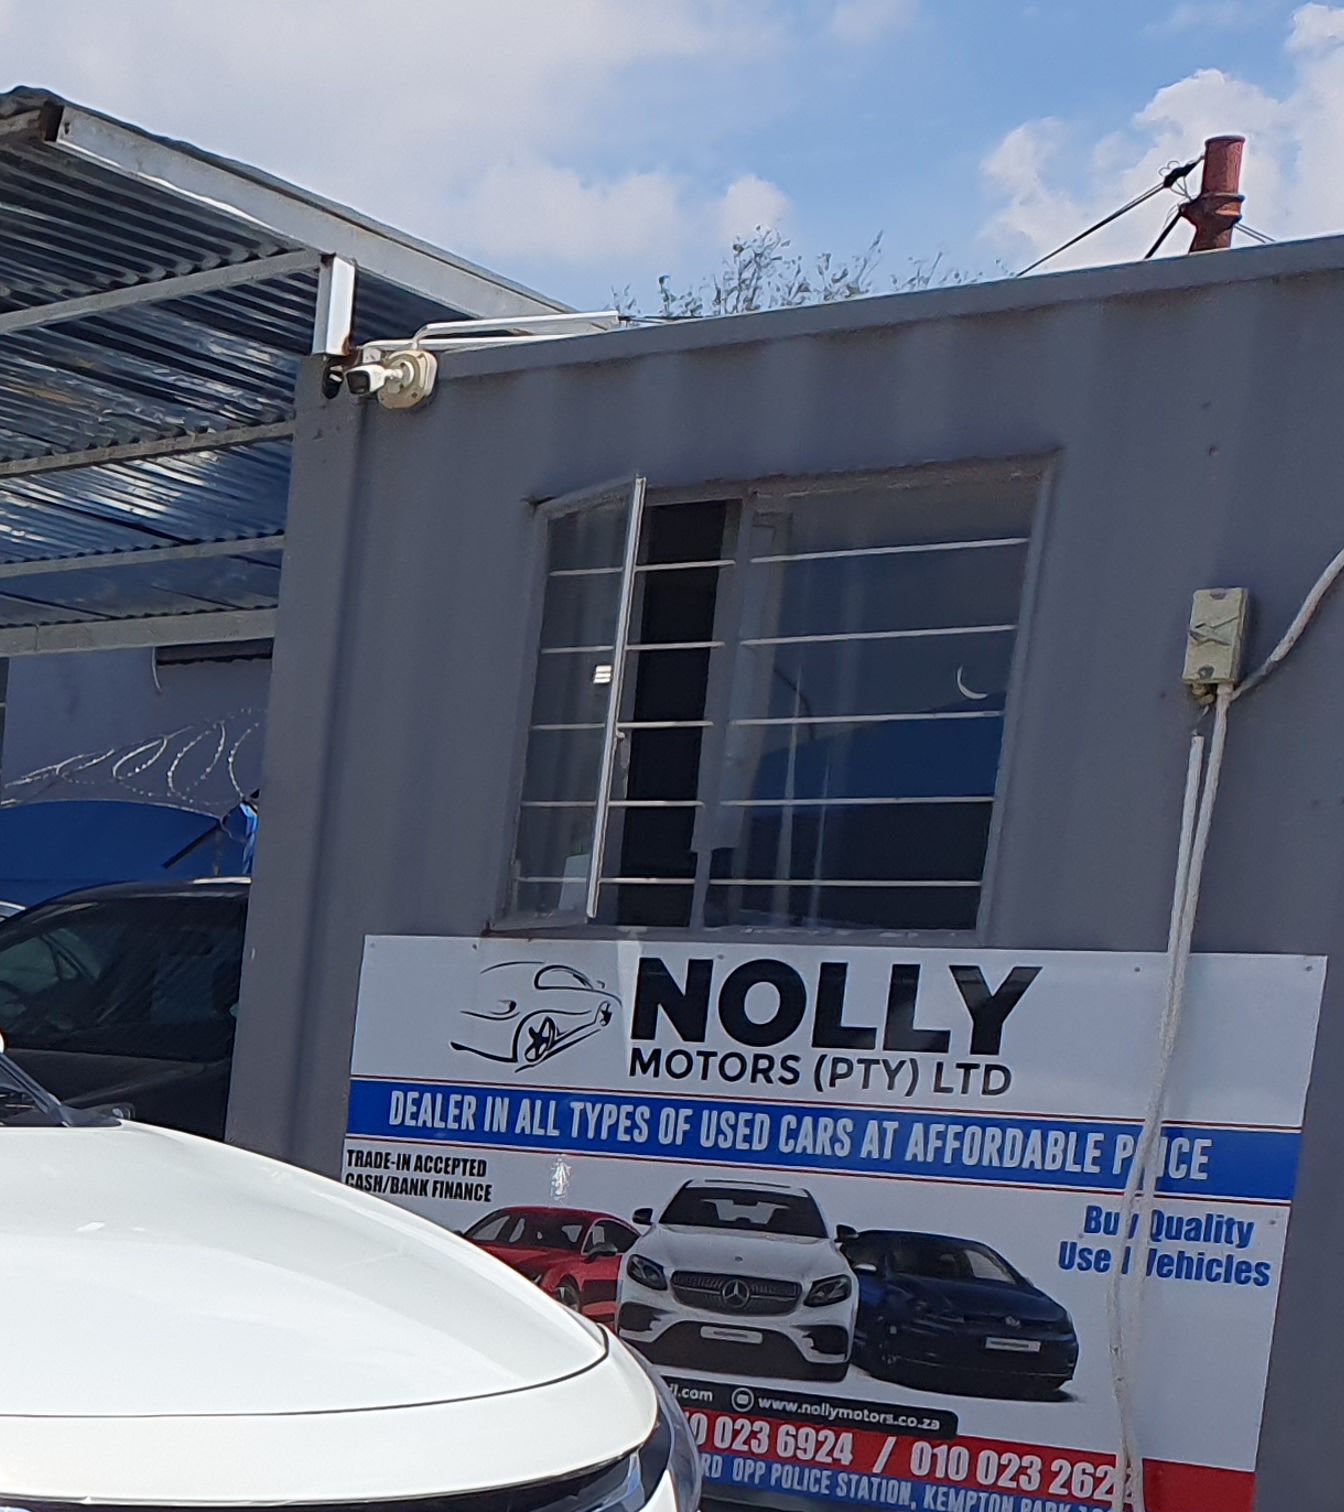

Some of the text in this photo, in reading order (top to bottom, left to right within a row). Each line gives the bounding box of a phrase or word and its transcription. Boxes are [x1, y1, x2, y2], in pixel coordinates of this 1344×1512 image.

[630, 956, 1044, 1056] NOLLY
[629, 1048, 1012, 1097] MOTORS (PTY) LTD
[389, 1090, 1213, 1181] DEALER IN ALL TYPES OF USED CARS AT AFFORDABLE PICE
[345, 1173, 493, 1202] CASH/BANK FINANCE
[347, 1149, 488, 1178] TRADE-IN ACCEPTED
[1150, 1209, 1254, 1249] Quality
[758, 1394, 941, 1431] www.nollymotors.co.za
[713, 1415, 769, 1454] 023
[776, 1424, 854, 1467] 6924
[910, 1441, 968, 1482] 010
[976, 1449, 1041, 1493] 023
[732, 1458, 766, 1485] OPP
[770, 1467, 831, 1496] POLICE
[835, 1472, 917, 1511] STATION,
